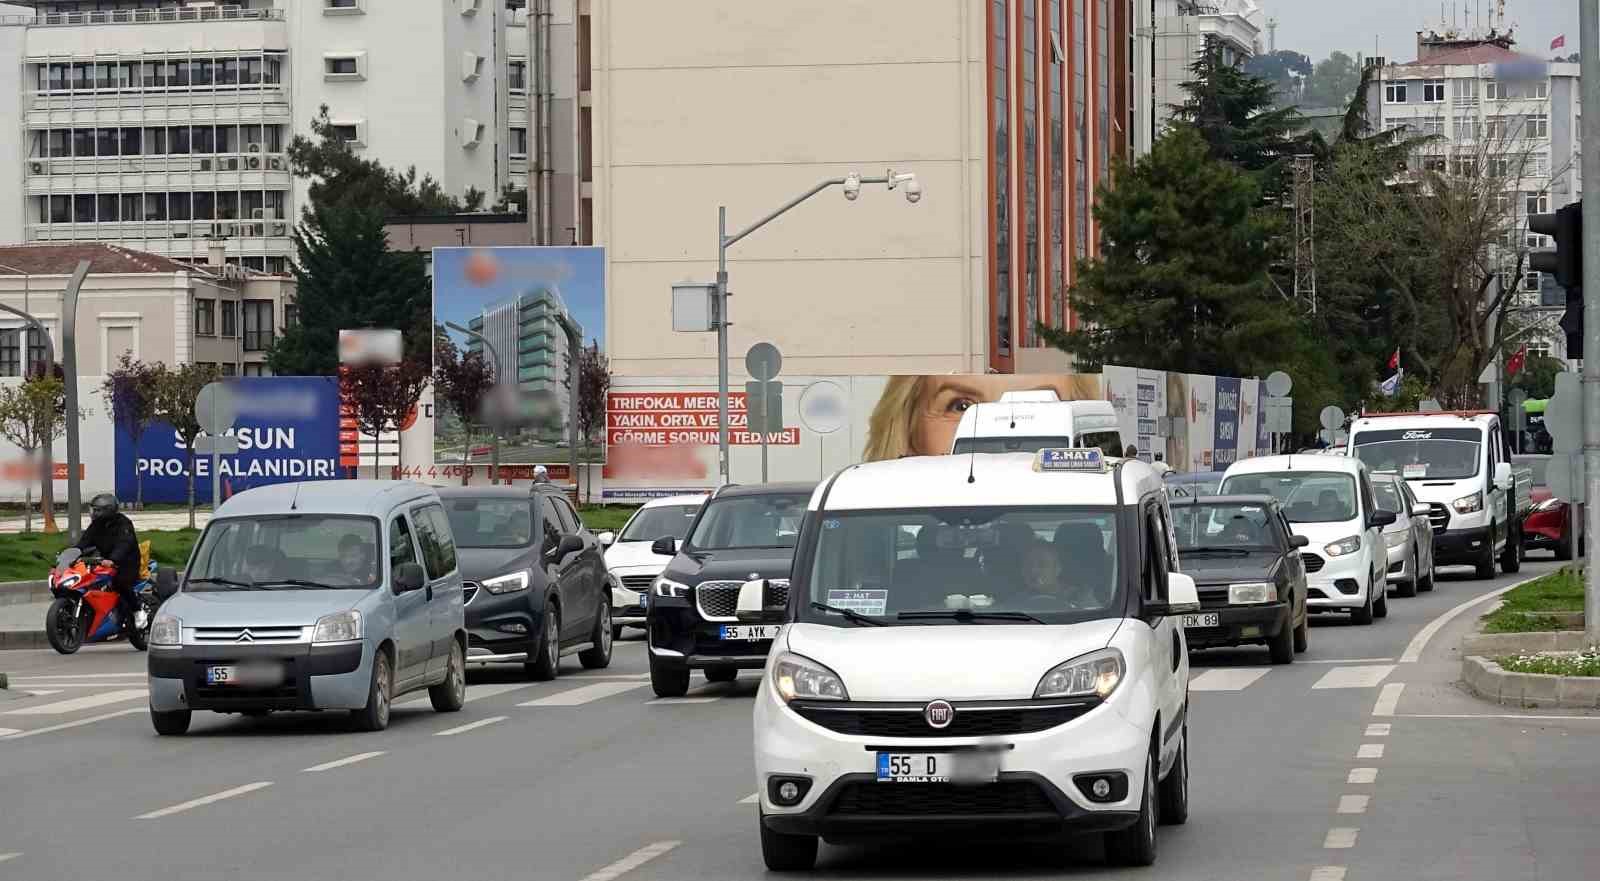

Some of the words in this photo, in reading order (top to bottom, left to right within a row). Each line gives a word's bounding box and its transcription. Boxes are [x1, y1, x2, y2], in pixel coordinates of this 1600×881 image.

[612, 414, 658, 428] YAKIN,
[660, 414, 698, 426] ORTA
[699, 414, 719, 426] VE
[174, 427, 295, 449] SSUN
[612, 430, 668, 444] GÖRME
[669, 431, 731, 444] SORUN
[1402, 430, 1433, 439] Ford
[218, 458, 335, 476] ALANIDIR!
[393, 464, 422, 479] 44
[427, 464, 438, 479] 4
[1204, 614, 1218, 626] 89
[726, 627, 738, 638] 55
[748, 626, 766, 638] AYK
[214, 667, 228, 680] 55
[931, 708, 948, 721] FIAT
[890, 756, 911, 775] 55
[927, 756, 937, 775] D
